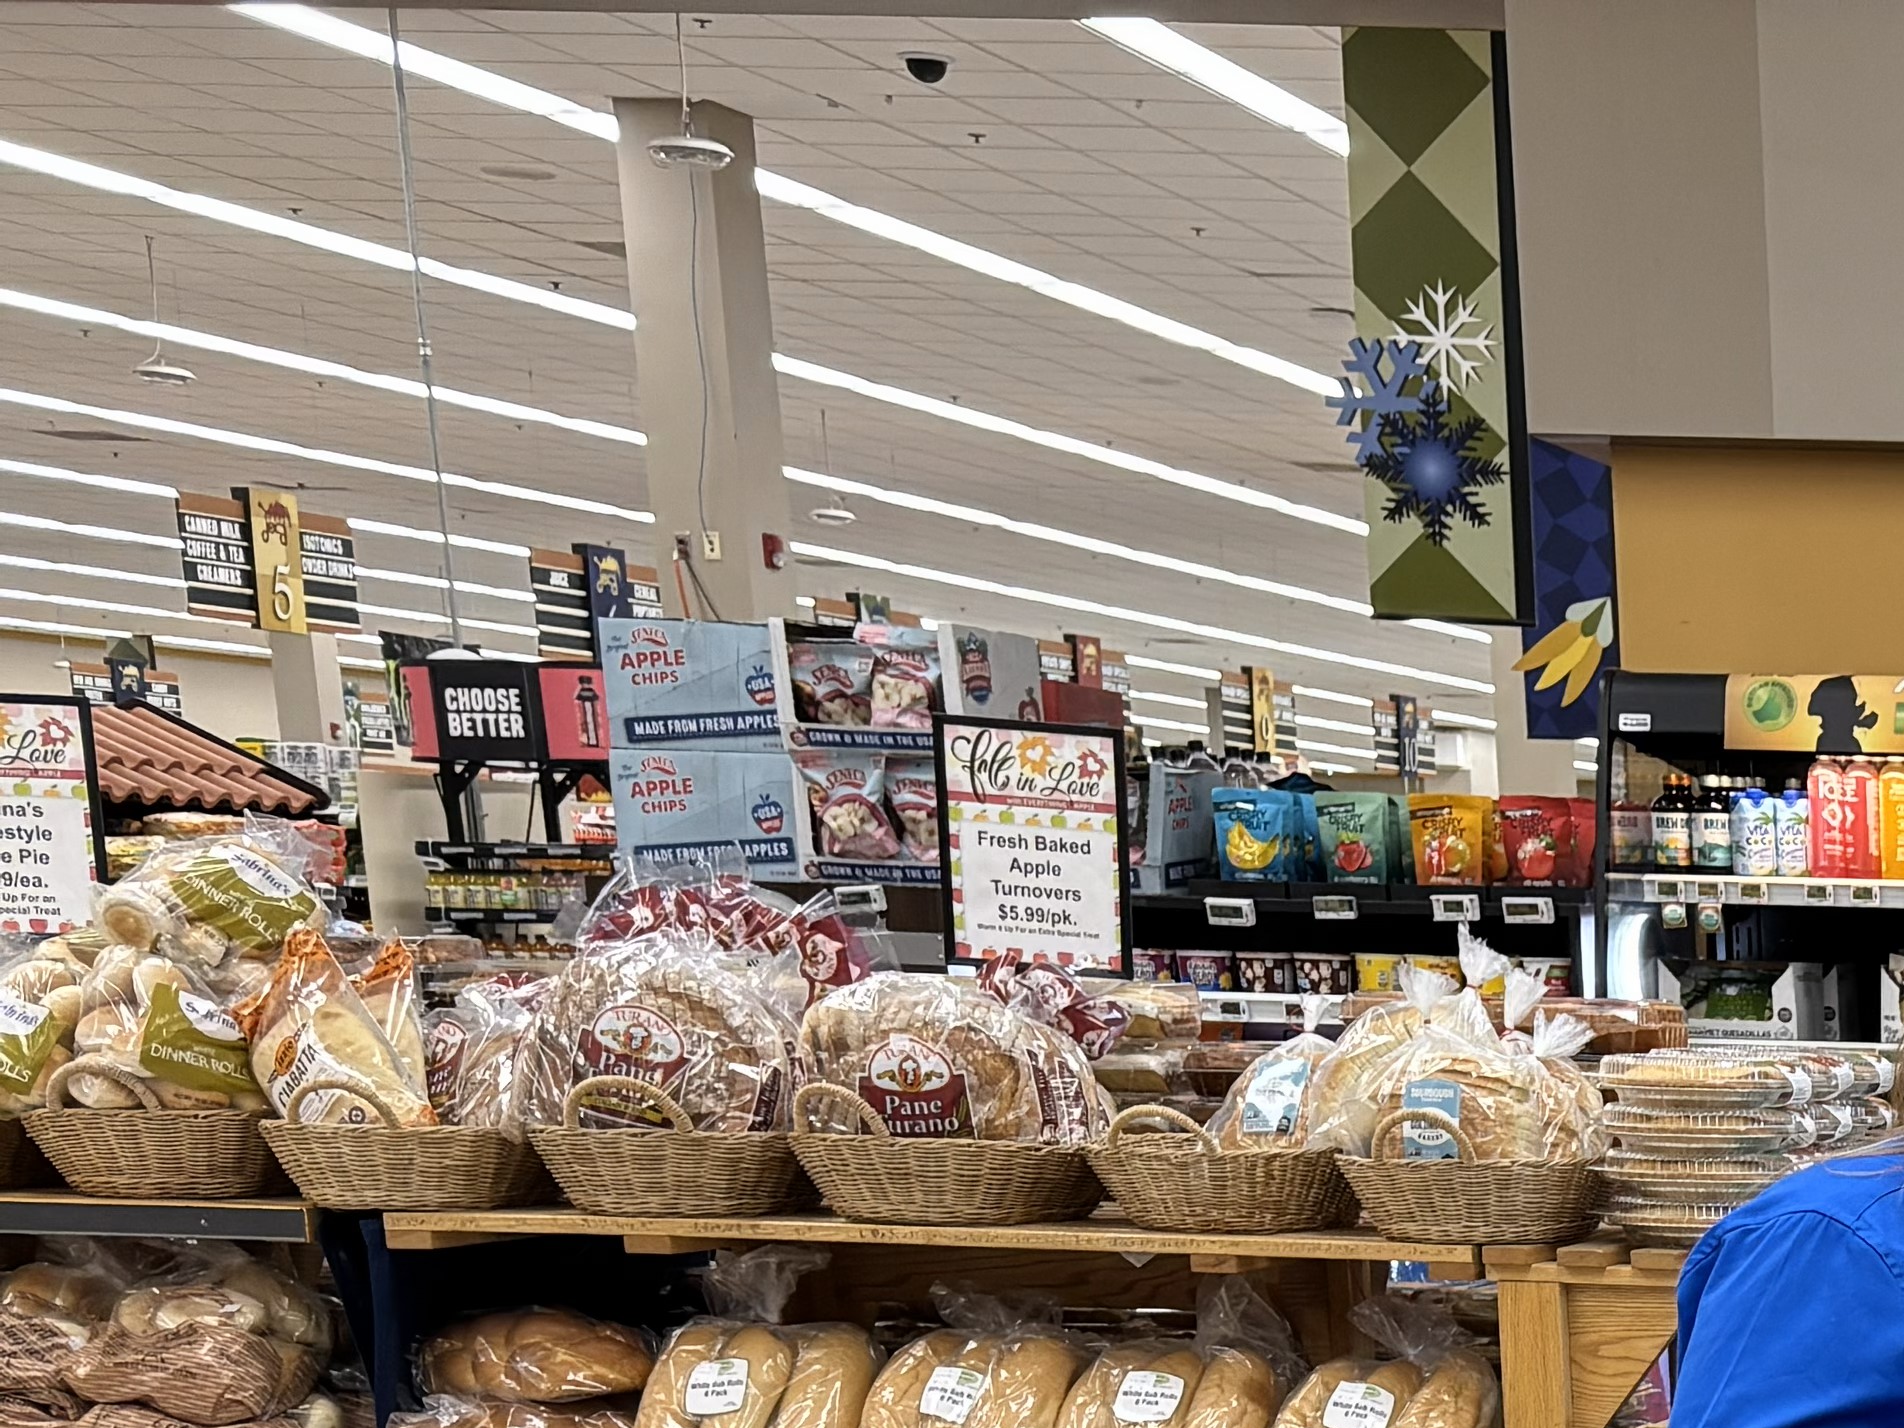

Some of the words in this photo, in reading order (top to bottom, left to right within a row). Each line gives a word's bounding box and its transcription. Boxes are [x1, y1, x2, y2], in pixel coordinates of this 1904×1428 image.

[274, 564, 292, 621] 5
[620, 650, 686, 671] APPLE
[631, 670, 679, 686] CHIPS
[445, 687, 521, 713] CHOOSE
[448, 712, 526, 738] BETTER
[634, 721, 666, 736] MADE
[668, 719, 698, 735] FROM
[699, 717, 735, 733] FRESH
[951, 729, 1017, 804] Fall
[1017, 772, 1037, 793] in
[1040, 761, 1100, 803] Love
[631, 777, 694, 799] APPLE
[641, 800, 687, 814] CHIPS
[745, 842, 788, 858] APPLES
[978, 831, 1028, 851] Fresh
[1036, 835, 1091, 855] Baked
[19, 849, 50, 865] Pie
[1009, 857, 1062, 879] Apple
[183, 872, 240, 918] DINNER
[991, 879, 1082, 902] Turnovers
[998, 904, 1077, 928] $5.99/pk.
[150, 1043, 209, 1066] DINNER
[885, 1095, 943, 1116] Pane
